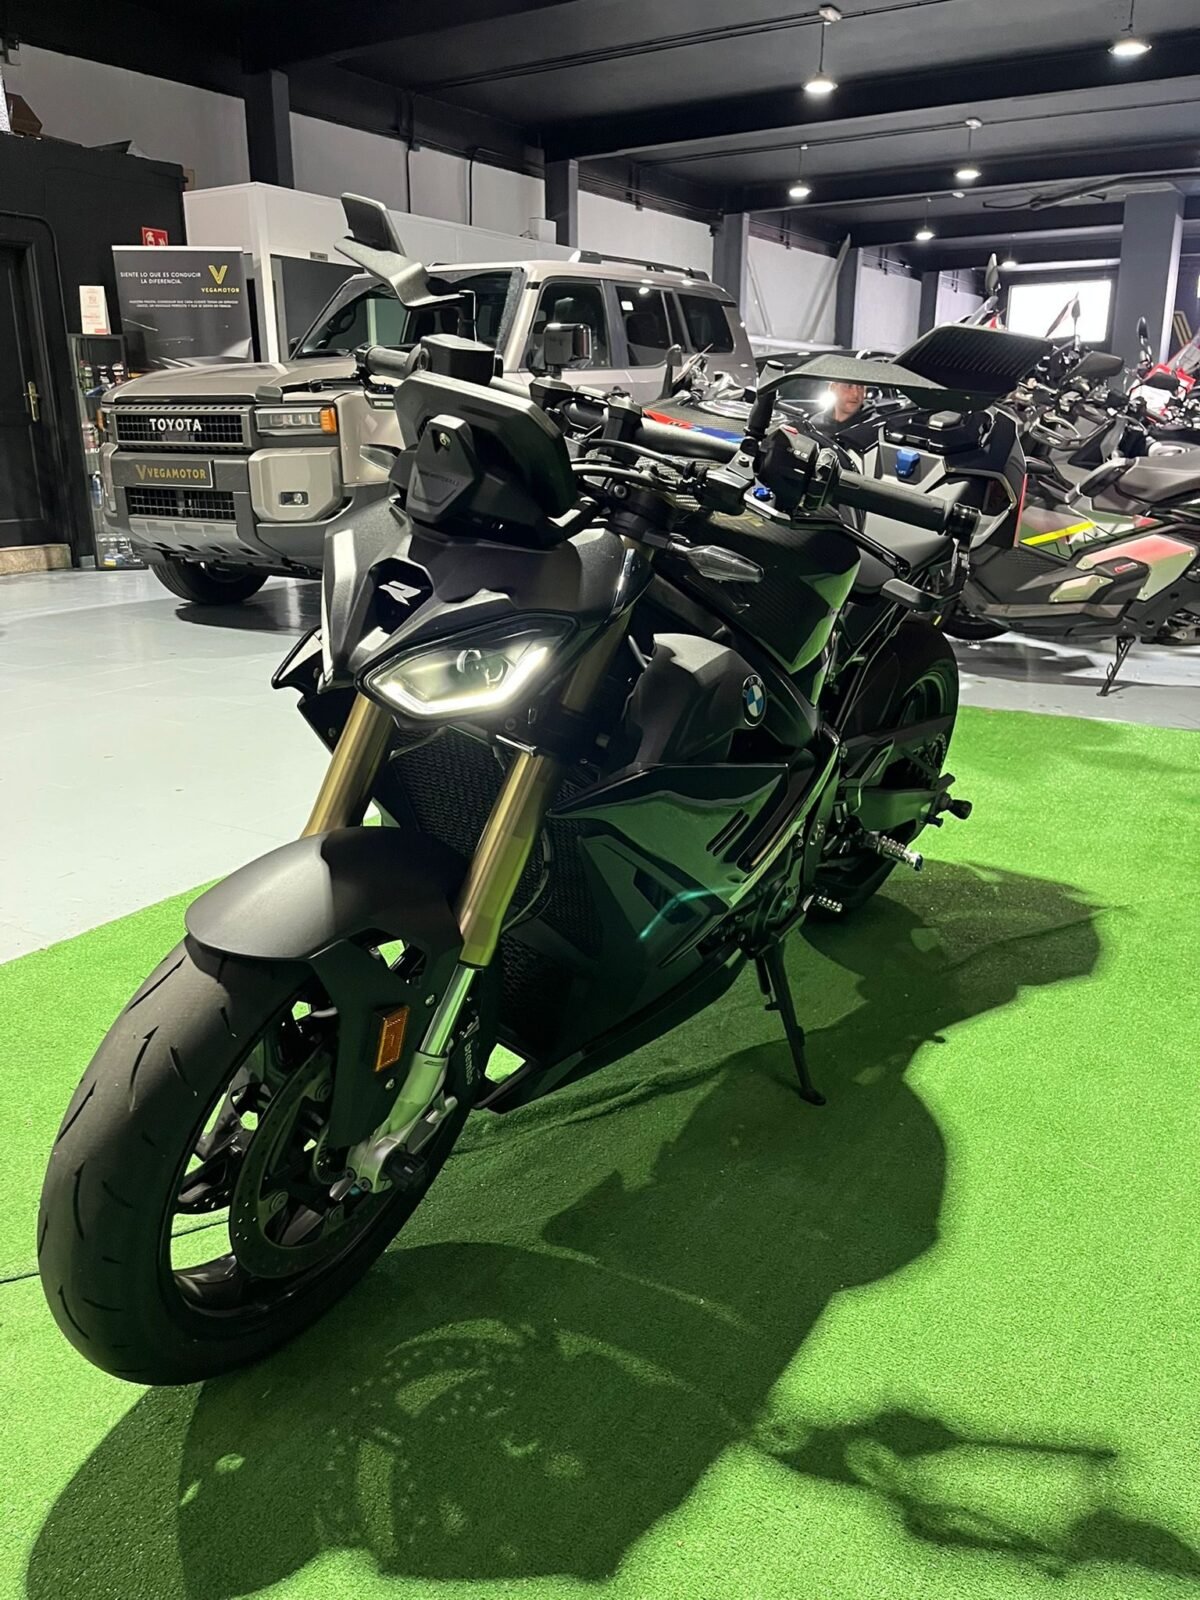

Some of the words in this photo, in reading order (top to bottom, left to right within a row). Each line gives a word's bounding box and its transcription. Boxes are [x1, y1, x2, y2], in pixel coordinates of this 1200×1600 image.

[149, 418, 202, 431] TOYOTA
[147, 467, 207, 480] VEGAMOTOR
[464, 1039, 475, 1085] brembo
